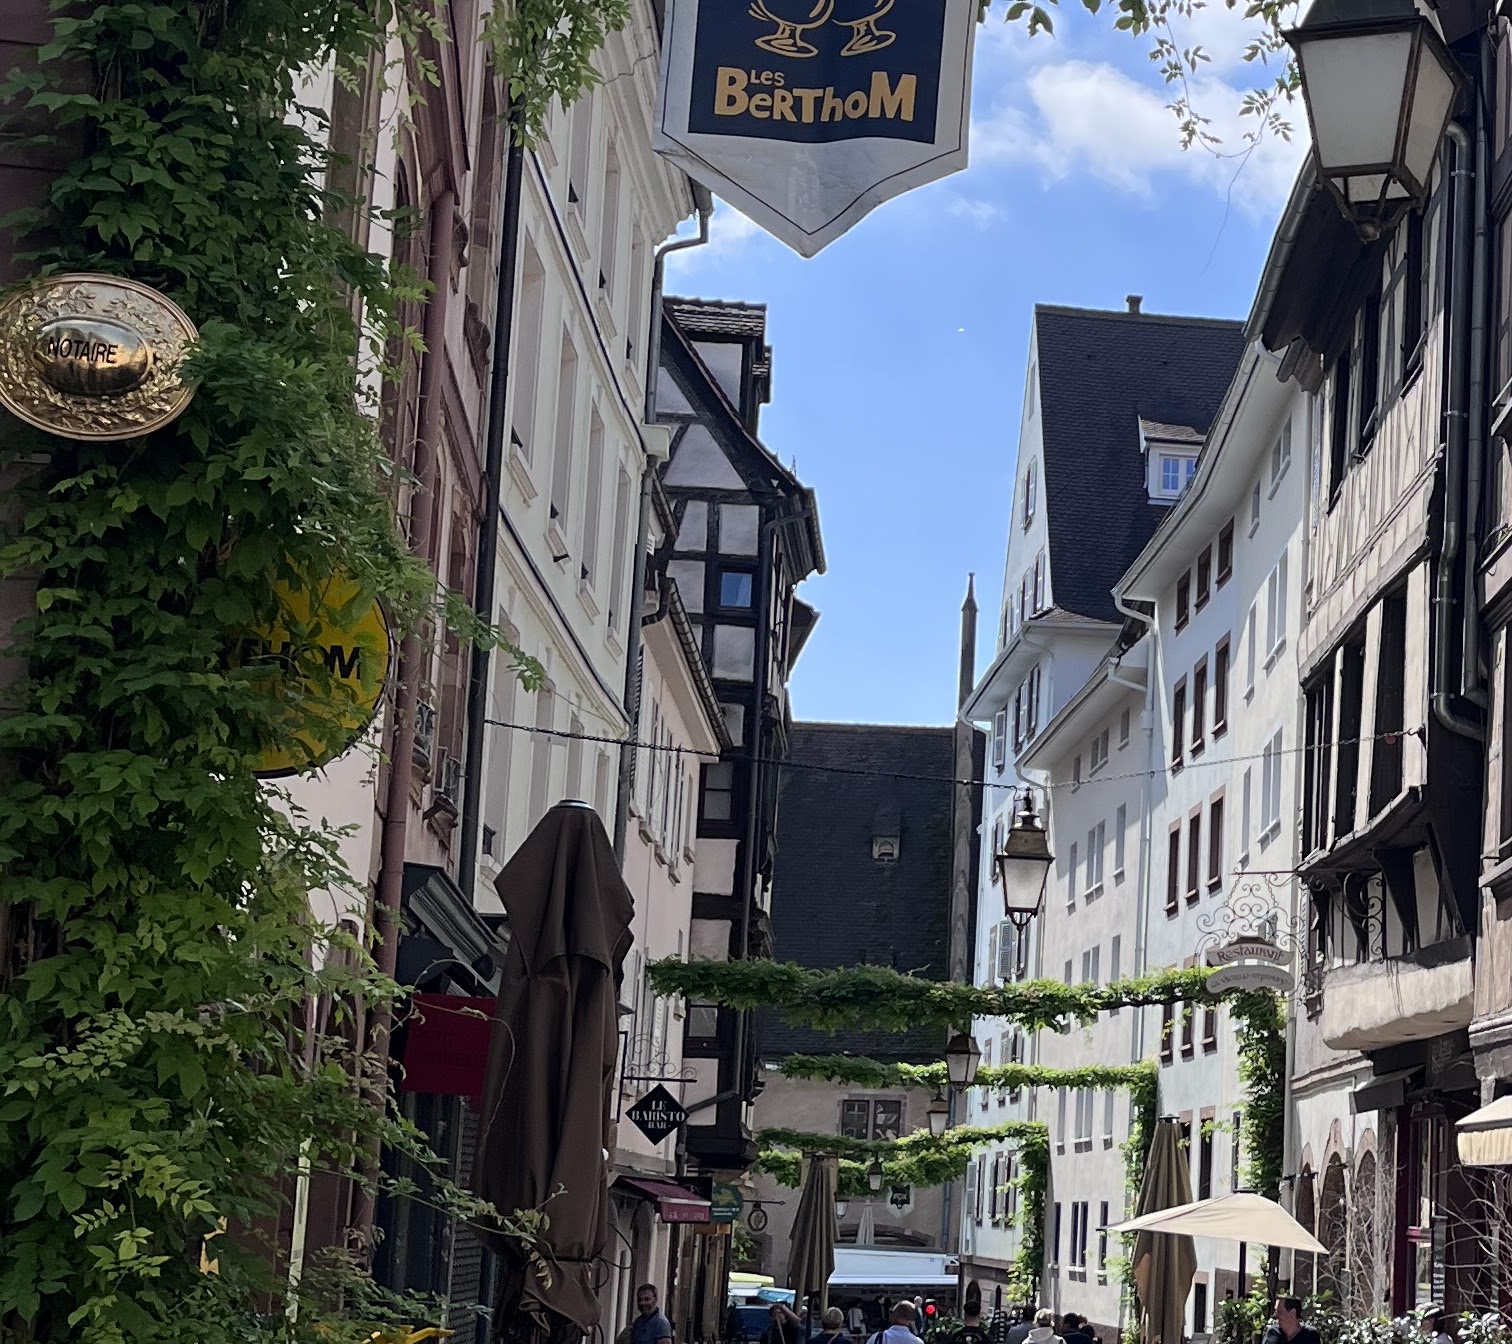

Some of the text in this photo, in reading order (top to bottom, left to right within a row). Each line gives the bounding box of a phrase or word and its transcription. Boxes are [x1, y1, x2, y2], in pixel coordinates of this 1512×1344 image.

[47, 336, 119, 364] NOTAIRE
[651, 1100, 668, 1111] LE
[631, 1110, 686, 1122] BARISTO
